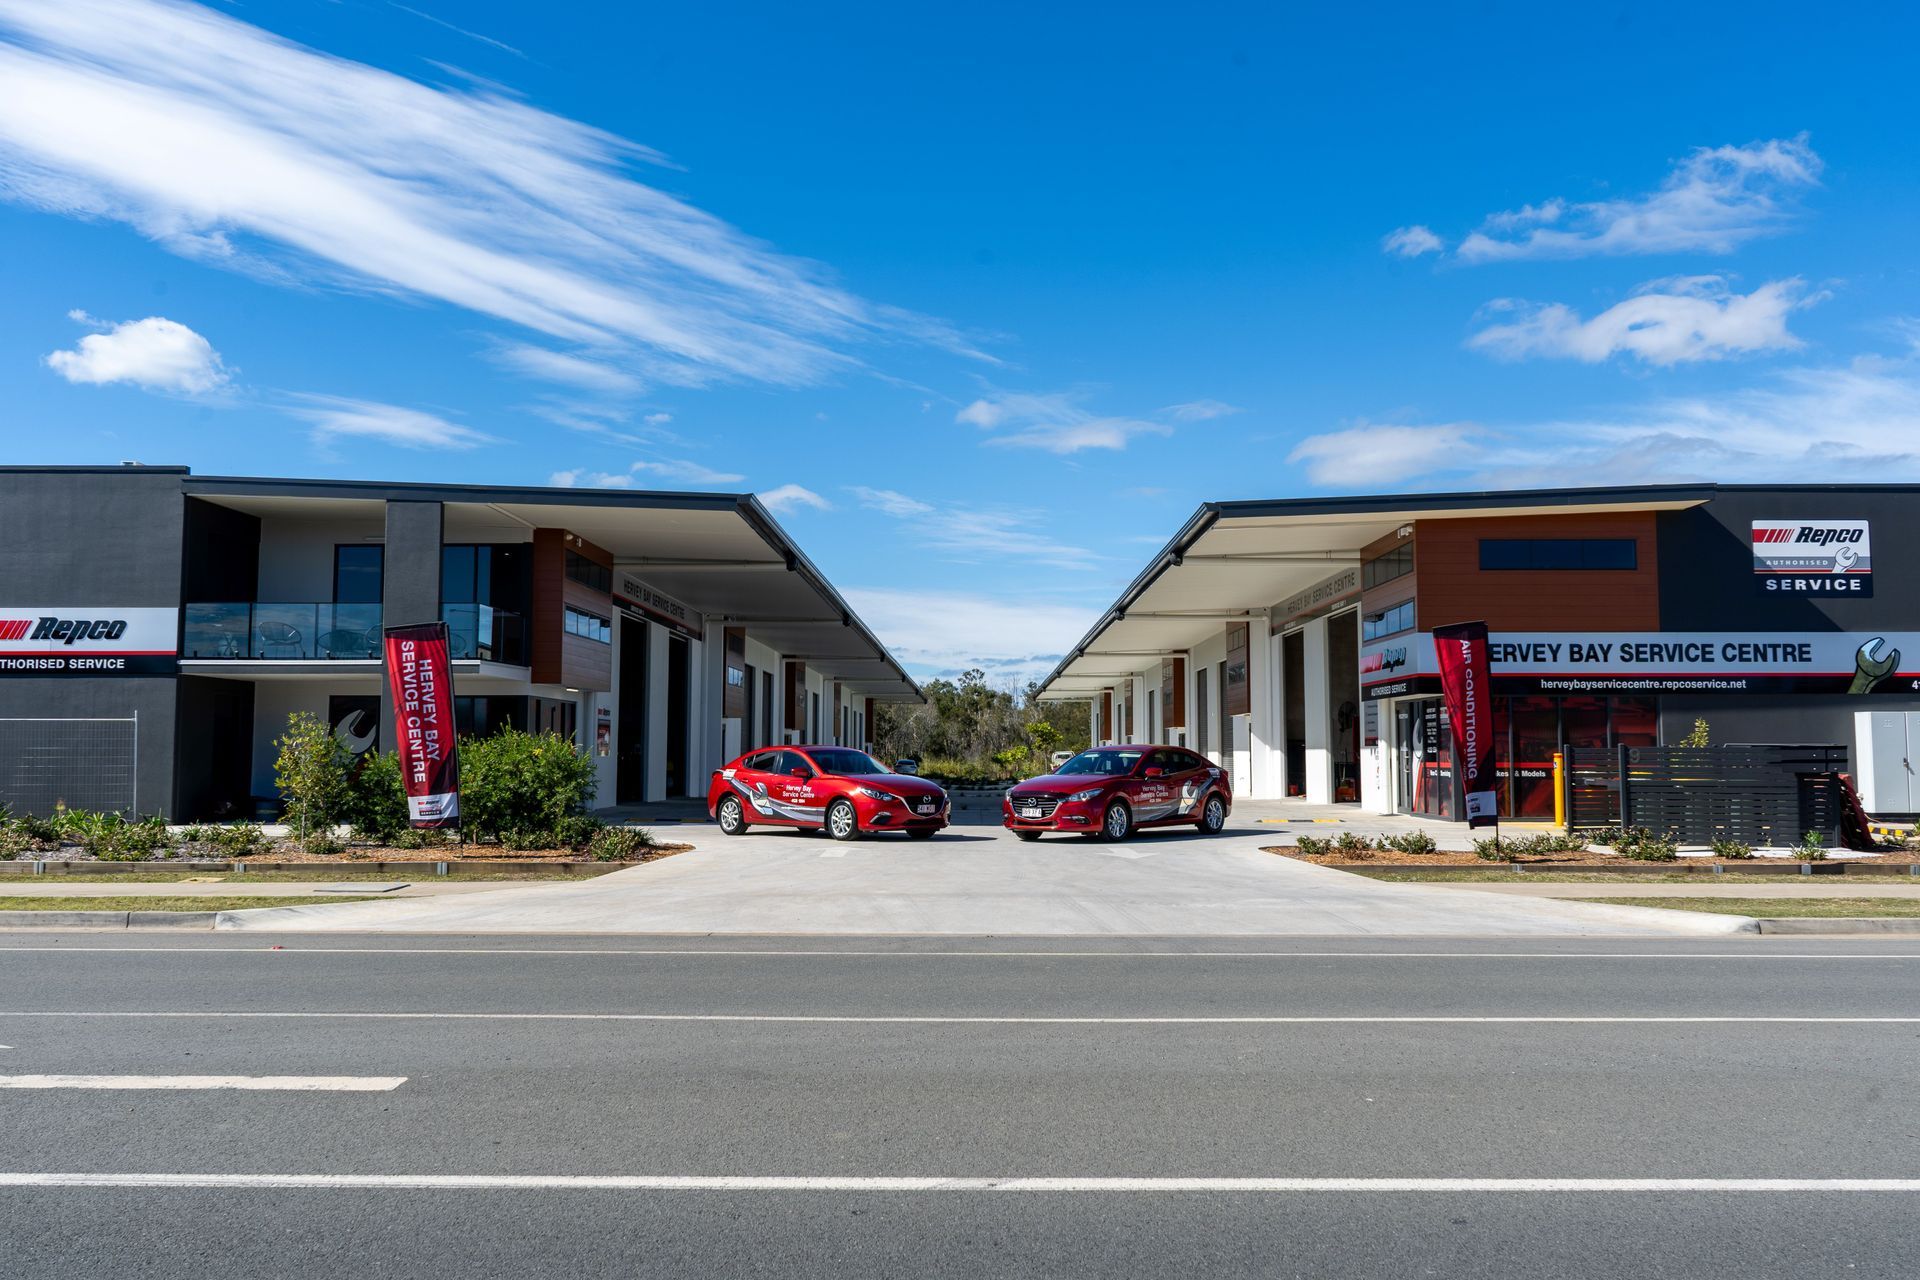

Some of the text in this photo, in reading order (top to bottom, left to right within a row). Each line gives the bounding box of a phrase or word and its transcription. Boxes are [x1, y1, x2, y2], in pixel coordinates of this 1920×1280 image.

[1795, 527, 1863, 546] Repco
[1334, 572, 1355, 593] CENTRE
[1766, 579, 1861, 590] SERVICE
[623, 579, 642, 599] HERVEY
[652, 593, 670, 613] SERVICE
[670, 602, 686, 620] CENTRE
[30, 617, 127, 645] Repco
[1488, 643, 1812, 663] ERVEY BAY SERVICE CENTRE
[0, 659, 125, 669] THORISED SERVICE
[1541, 679, 1746, 690] herveybayservicecentre.repcoservice.net
[1911, 680, 1920, 690] 4
[401, 641, 426, 783] SERVICE CENTRE
[419, 659, 441, 761] HERVEY BAY
[1460, 639, 1478, 779] AIR CONDITIONING
[802, 785, 812, 793] Bay
